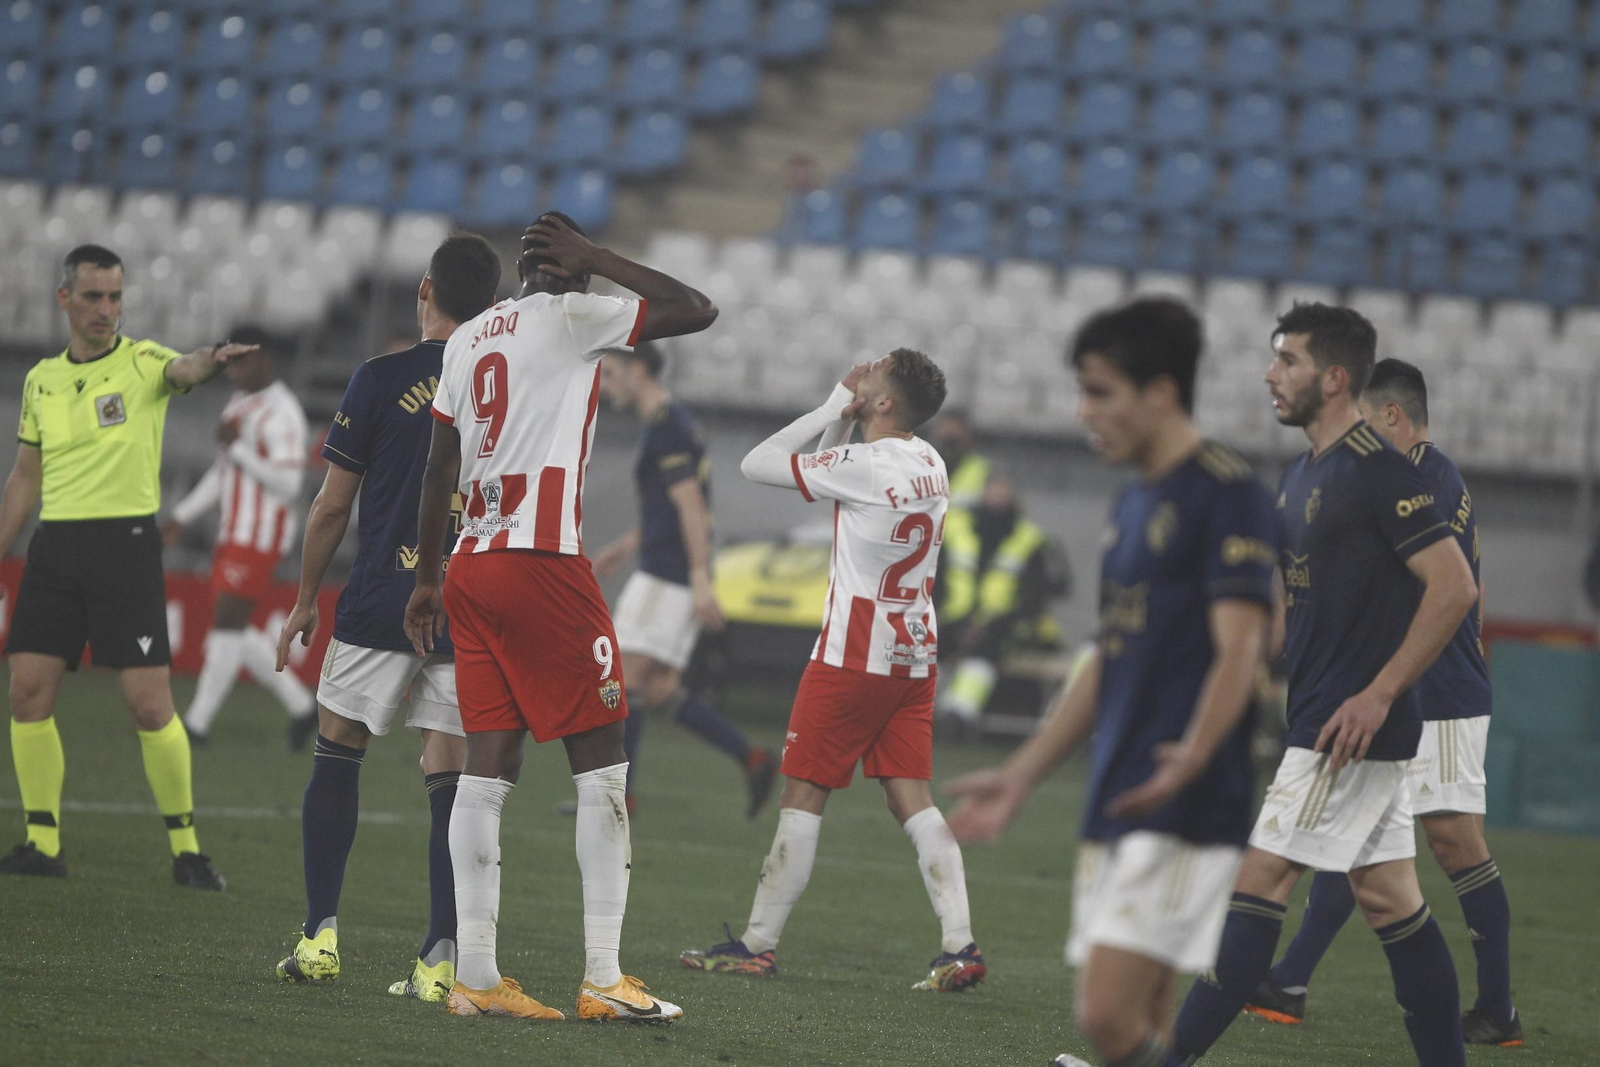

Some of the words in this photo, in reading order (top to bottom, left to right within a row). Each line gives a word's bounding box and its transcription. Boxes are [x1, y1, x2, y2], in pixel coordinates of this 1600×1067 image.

[471, 310, 520, 350] SADIQ
[470, 351, 509, 459] 9
[885, 486, 909, 510] F.
[592, 635, 613, 681] 9
